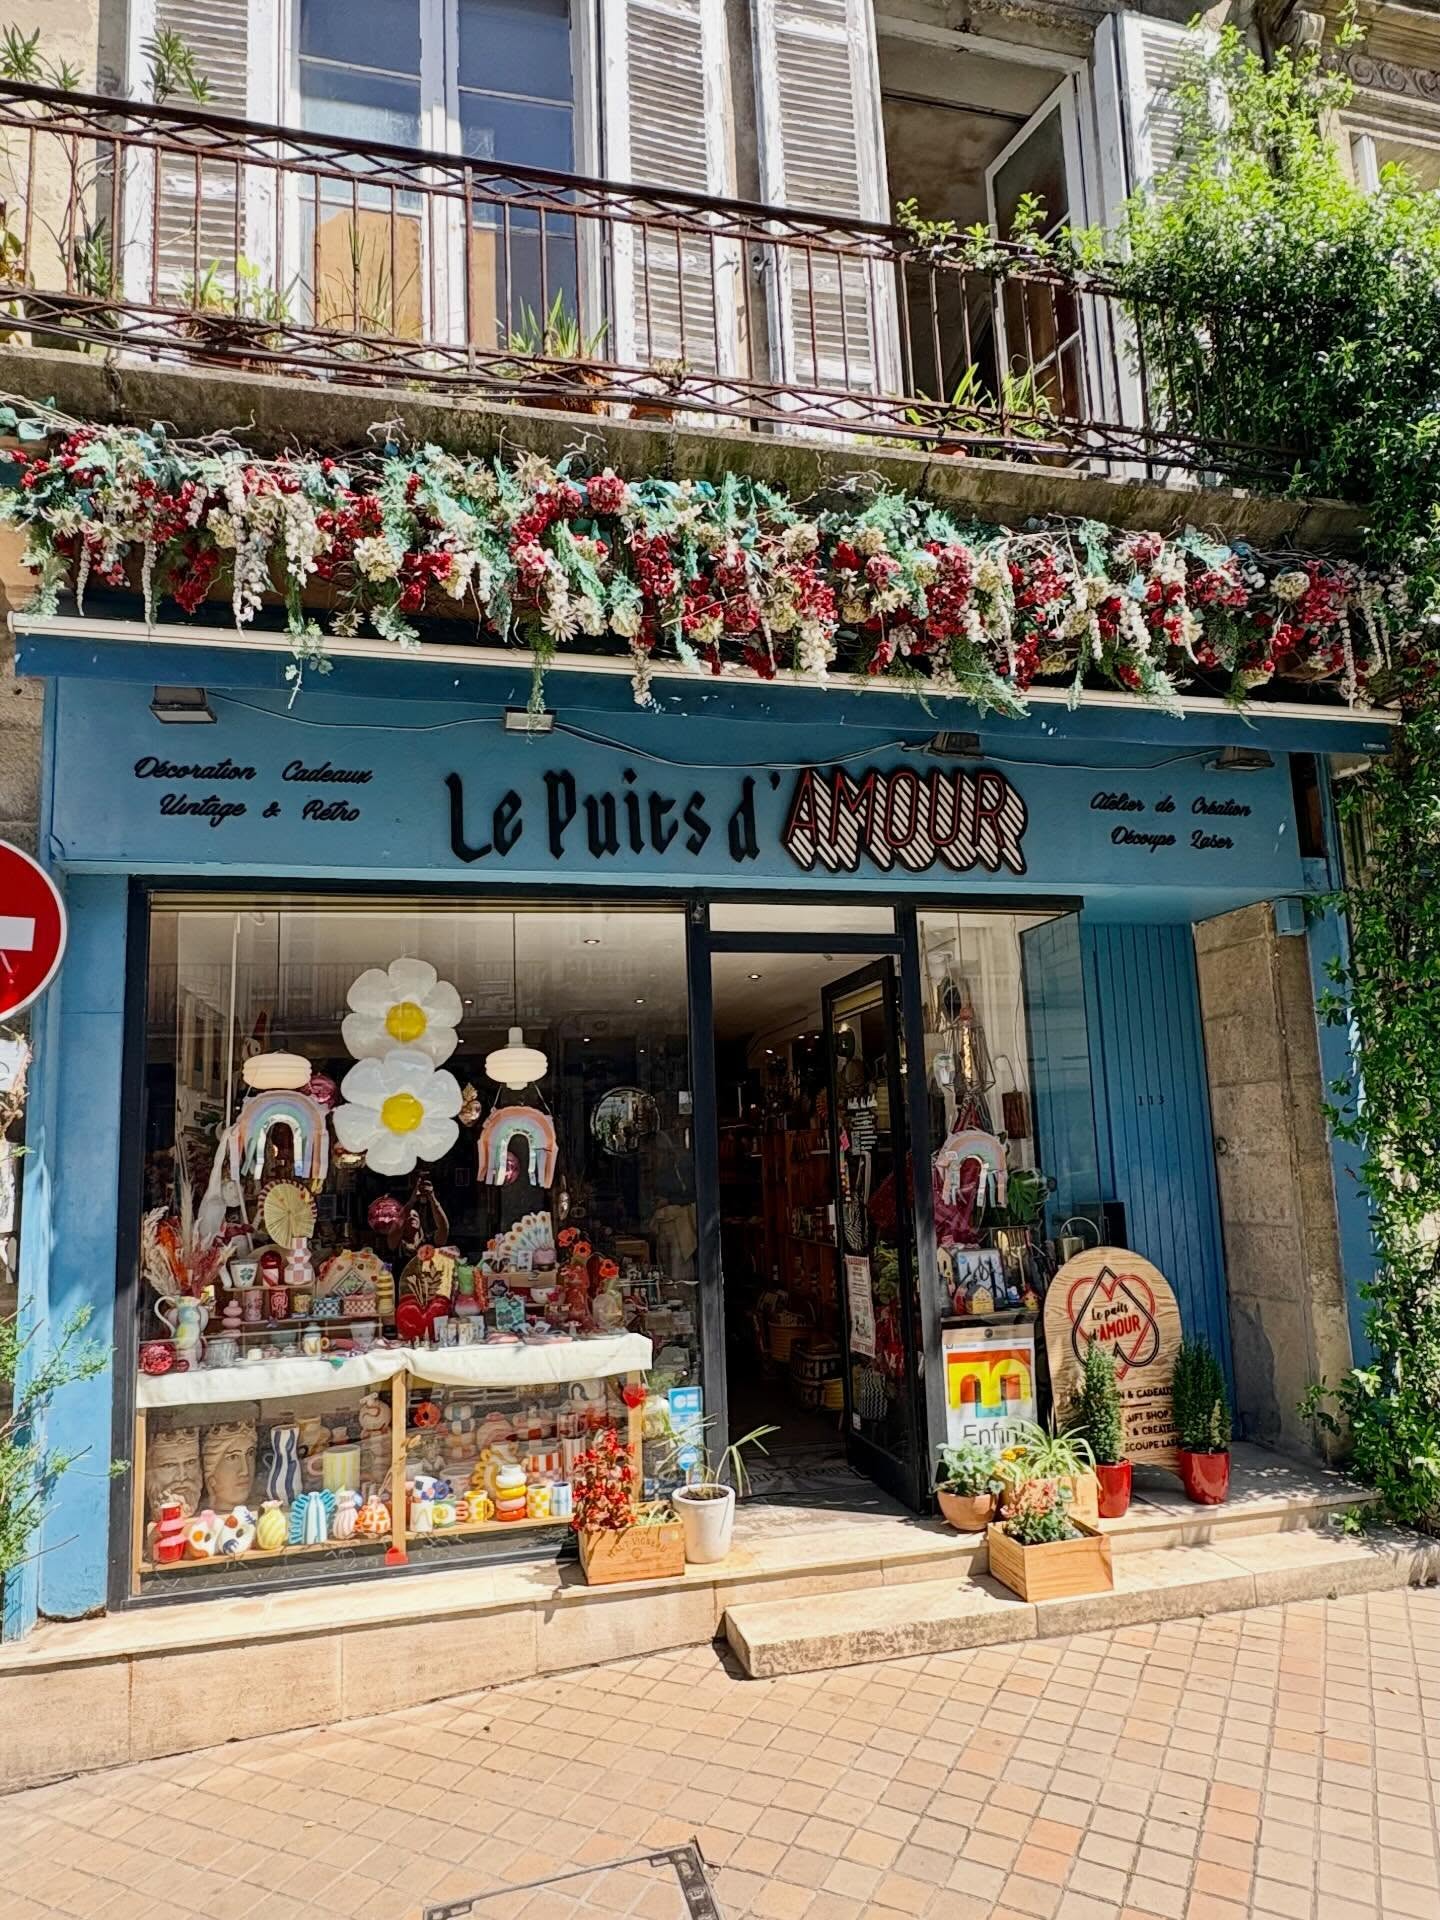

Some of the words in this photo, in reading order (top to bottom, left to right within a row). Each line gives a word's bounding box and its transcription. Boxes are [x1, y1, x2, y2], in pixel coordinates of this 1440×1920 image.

[281, 760, 373, 784] Cadeaux
[159, 793, 247, 828] Vintage
[262, 801, 281, 818] &
[1090, 791, 1145, 812] Atelier
[1155, 795, 1176, 813] de
[444, 772, 523, 863] Le
[543, 768, 711, 859] Puits
[1190, 829, 1234, 849] Laser
[1104, 1301, 1129, 1321] puits
[1146, 1410, 1169, 1420] SHOP
